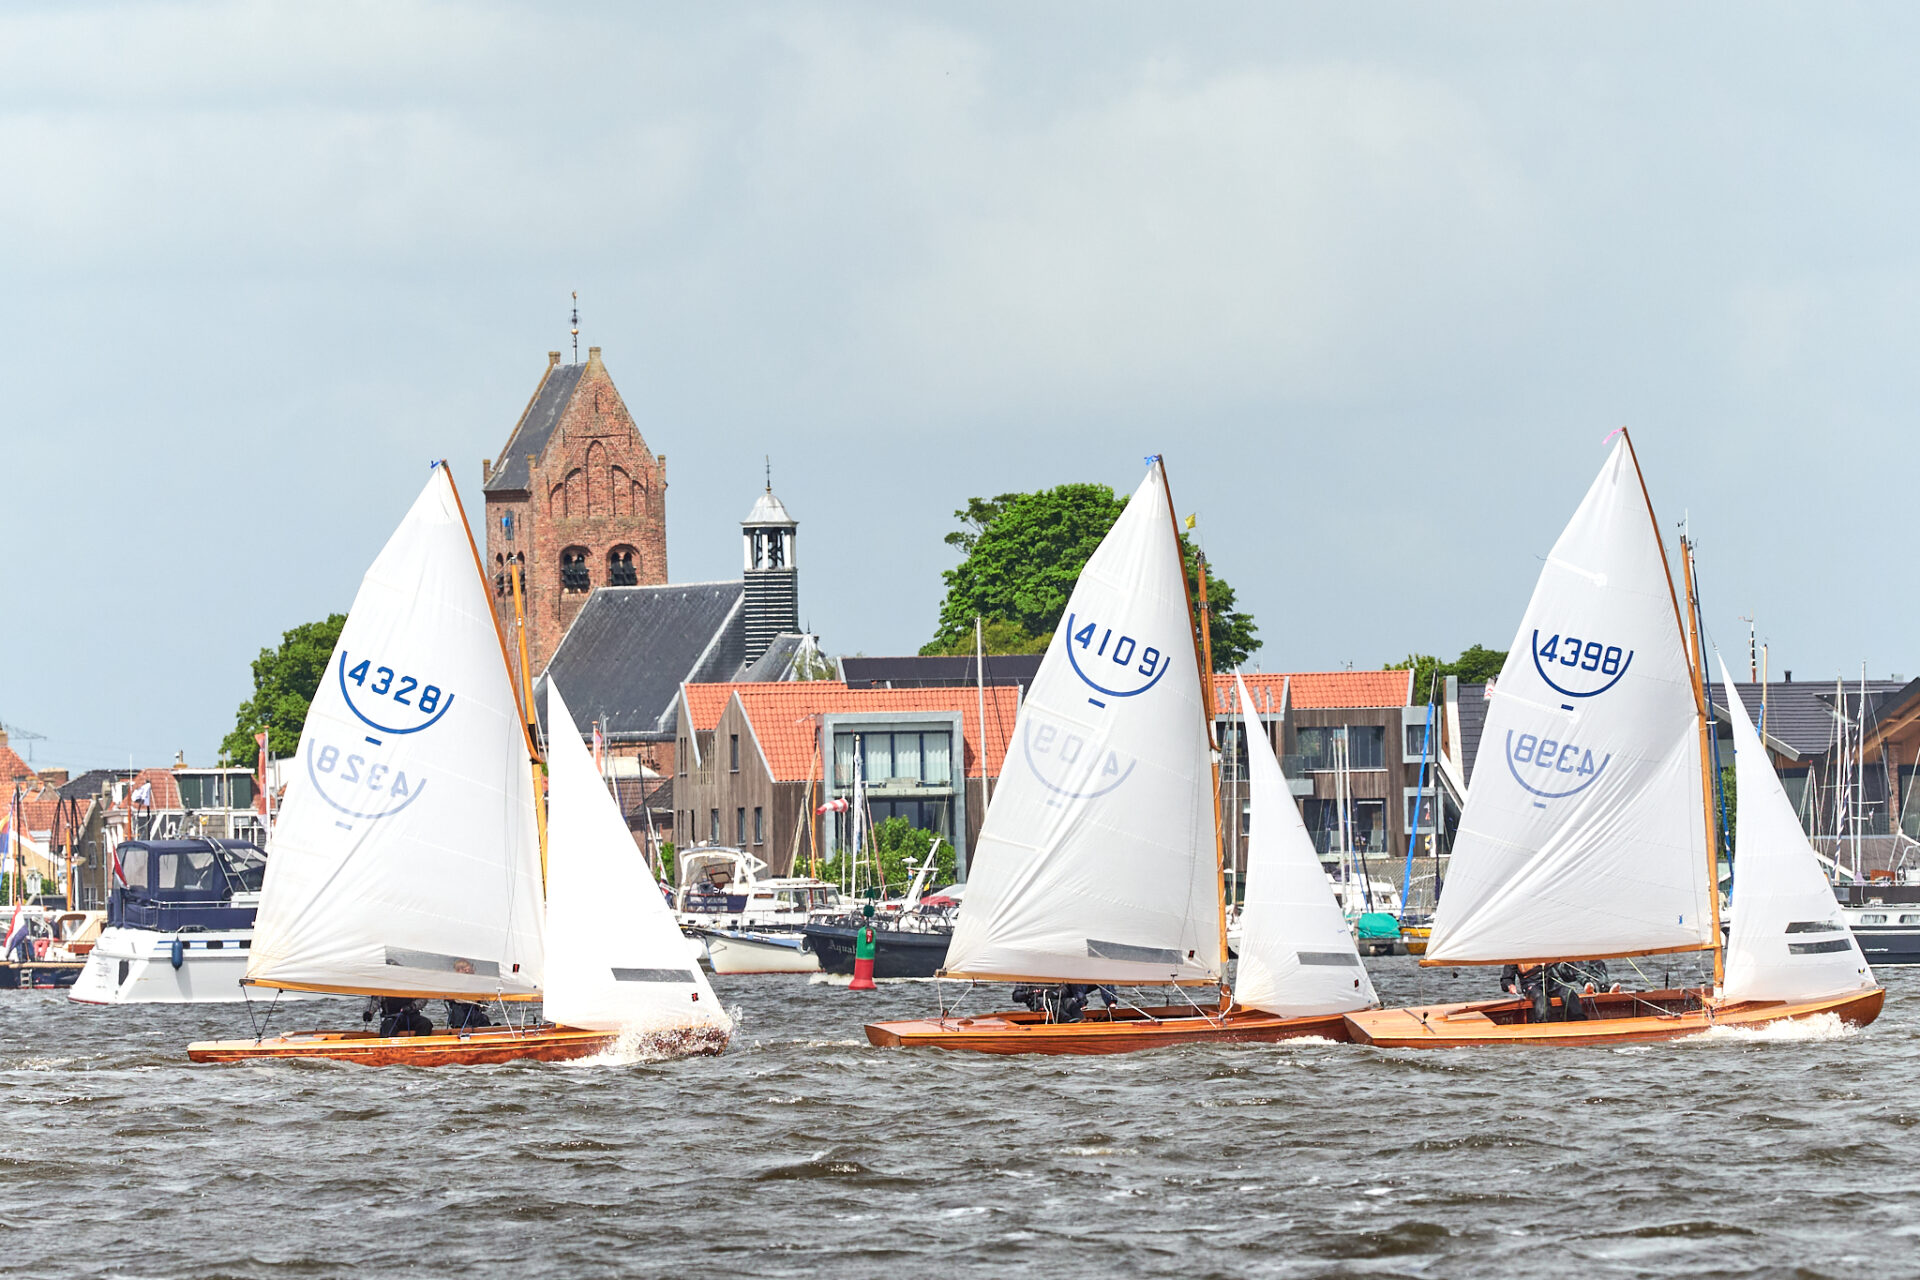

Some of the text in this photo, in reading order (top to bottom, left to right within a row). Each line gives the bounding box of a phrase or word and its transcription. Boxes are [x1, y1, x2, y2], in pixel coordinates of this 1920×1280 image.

[1074, 622, 1160, 677] 4109
[1539, 634, 1622, 676] 4398
[348, 659, 441, 714] 4328
